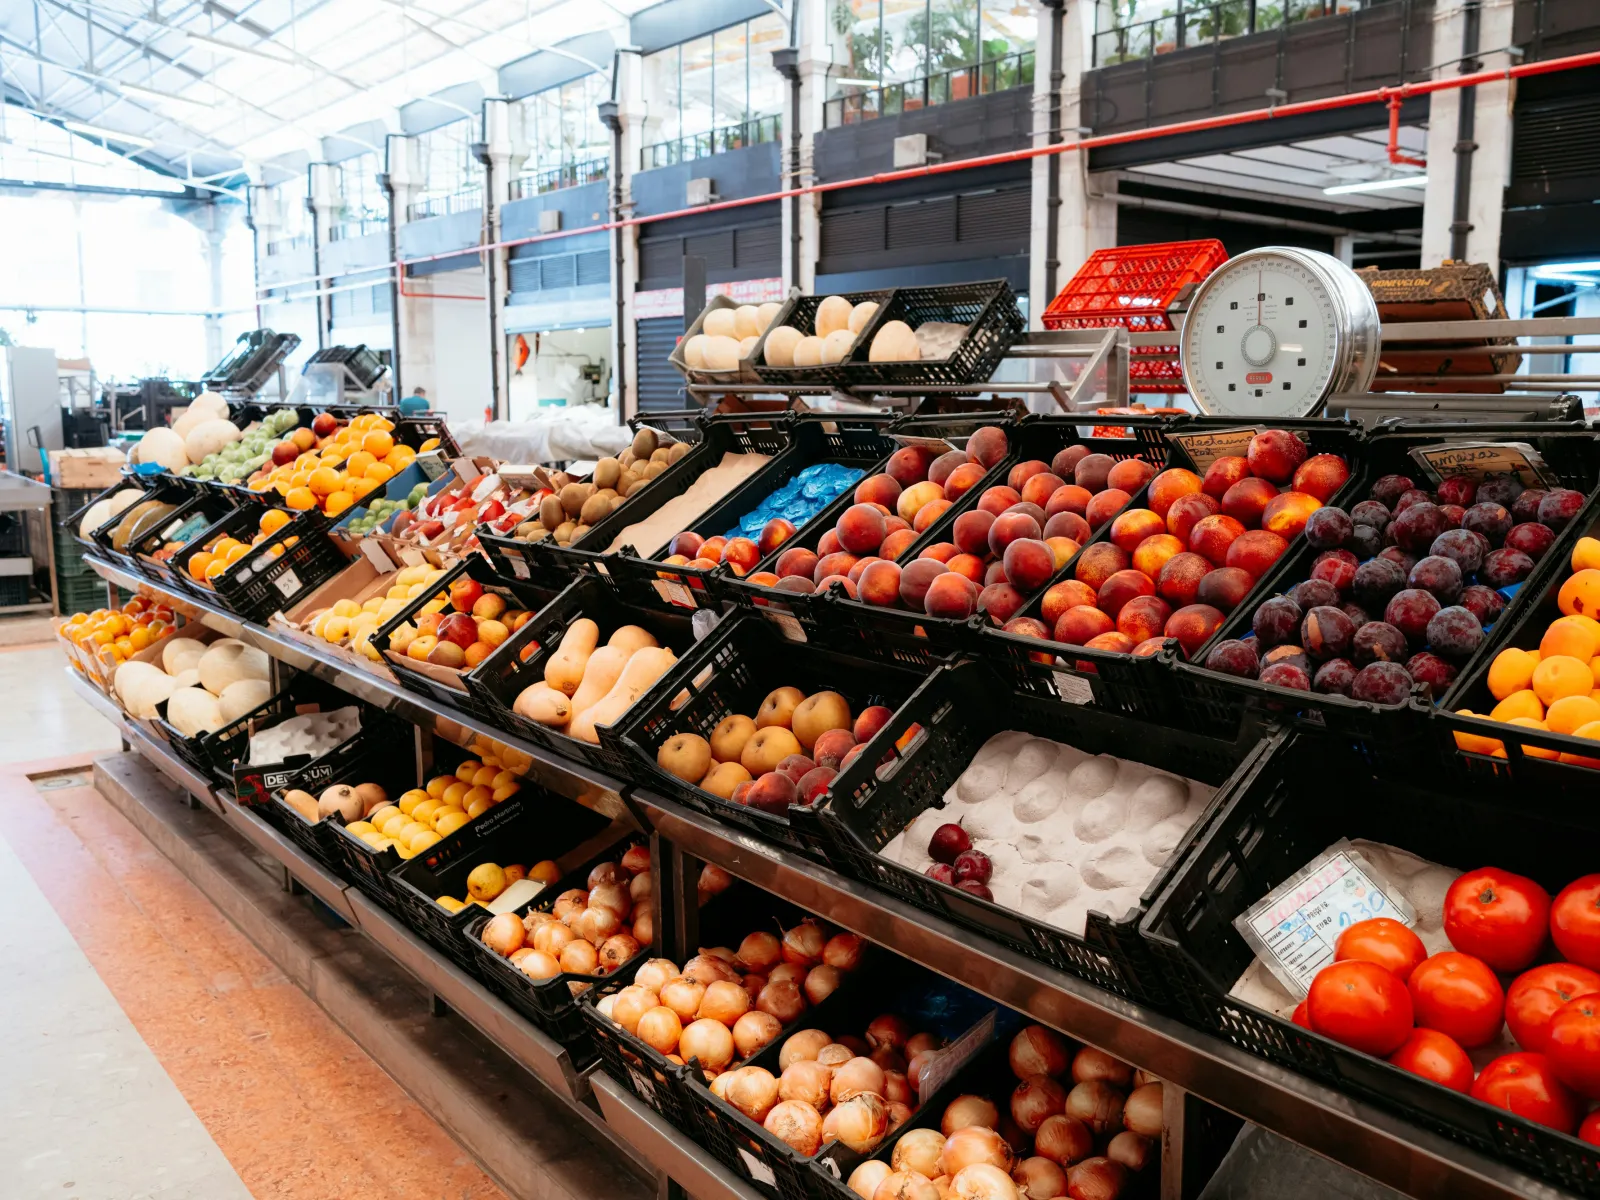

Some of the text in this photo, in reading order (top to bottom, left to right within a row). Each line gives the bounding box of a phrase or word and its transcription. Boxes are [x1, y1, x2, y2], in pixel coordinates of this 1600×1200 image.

[1371, 278, 1432, 288] HONEYGLOW
[475, 801, 521, 833] Pedro Martinho
[1265, 860, 1345, 926] TOMATES
[1315, 915, 1332, 931] EURO
